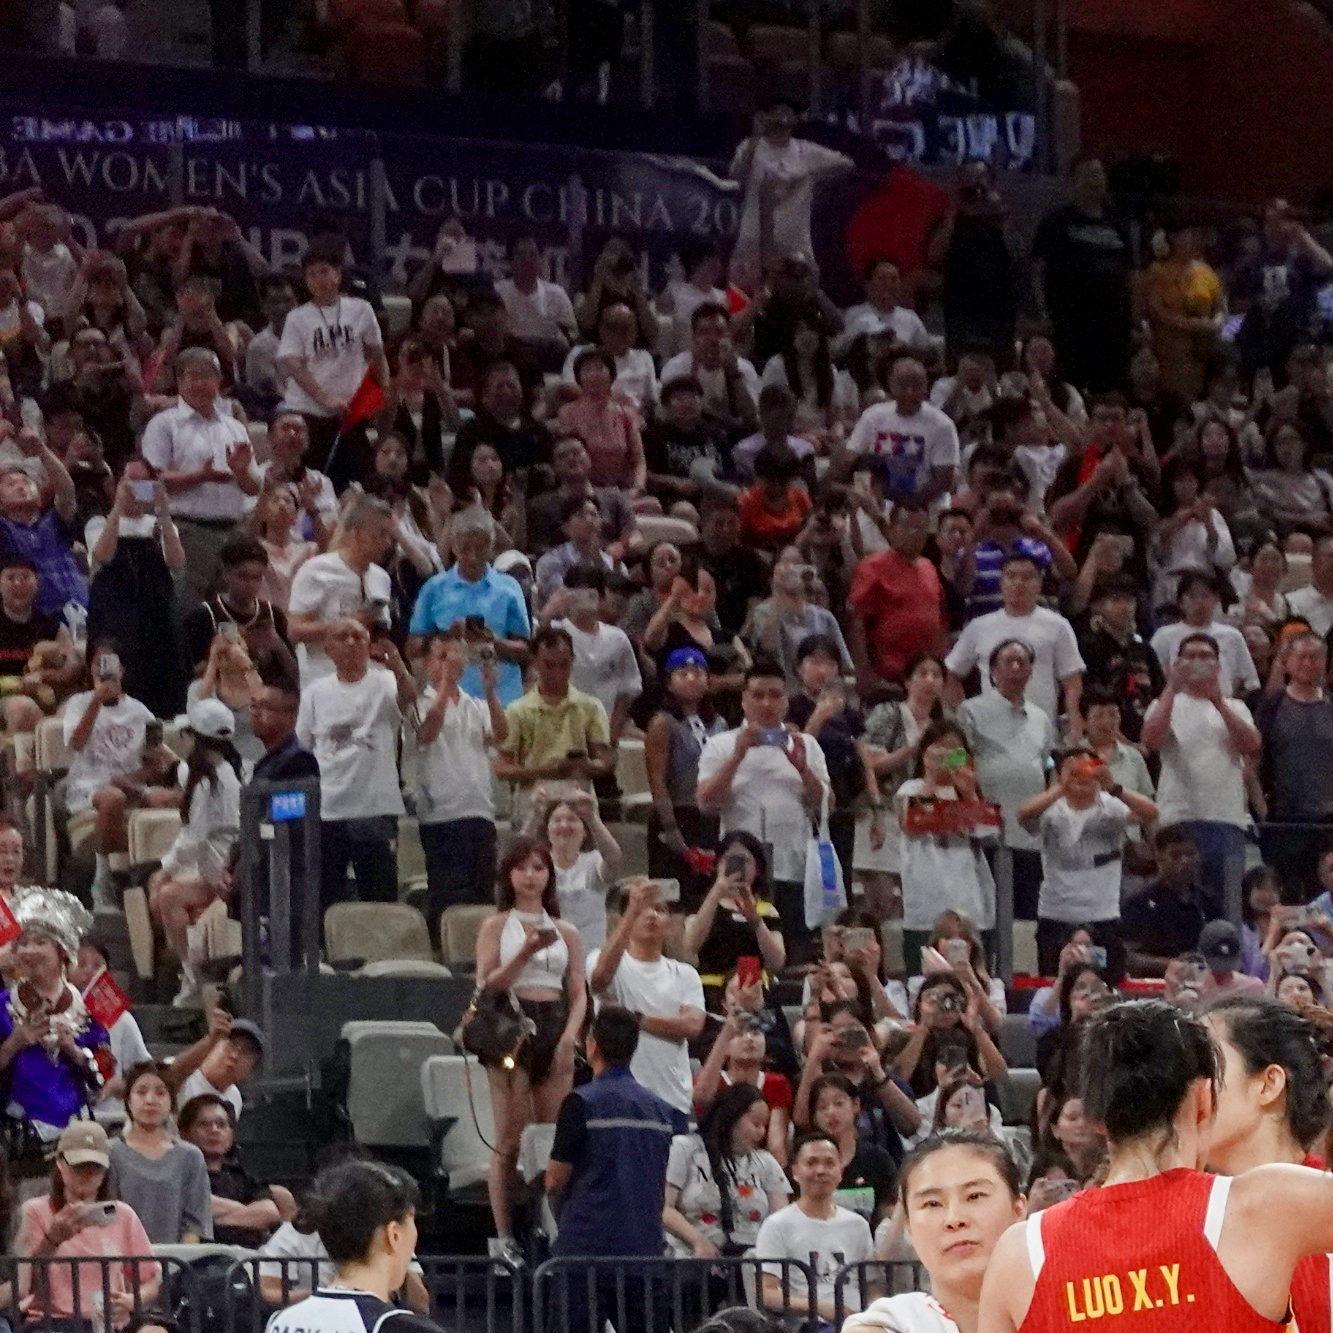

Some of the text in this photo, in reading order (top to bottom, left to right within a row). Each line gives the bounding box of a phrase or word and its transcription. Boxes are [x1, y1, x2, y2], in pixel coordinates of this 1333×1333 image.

[58, 147, 282, 202] WOMEN'S
[299, 168, 399, 212] ASIA
[413, 176, 509, 219] CUP
[523, 182, 674, 231] CHINA
[1066, 1264, 1195, 1322] LUO X.Y.
